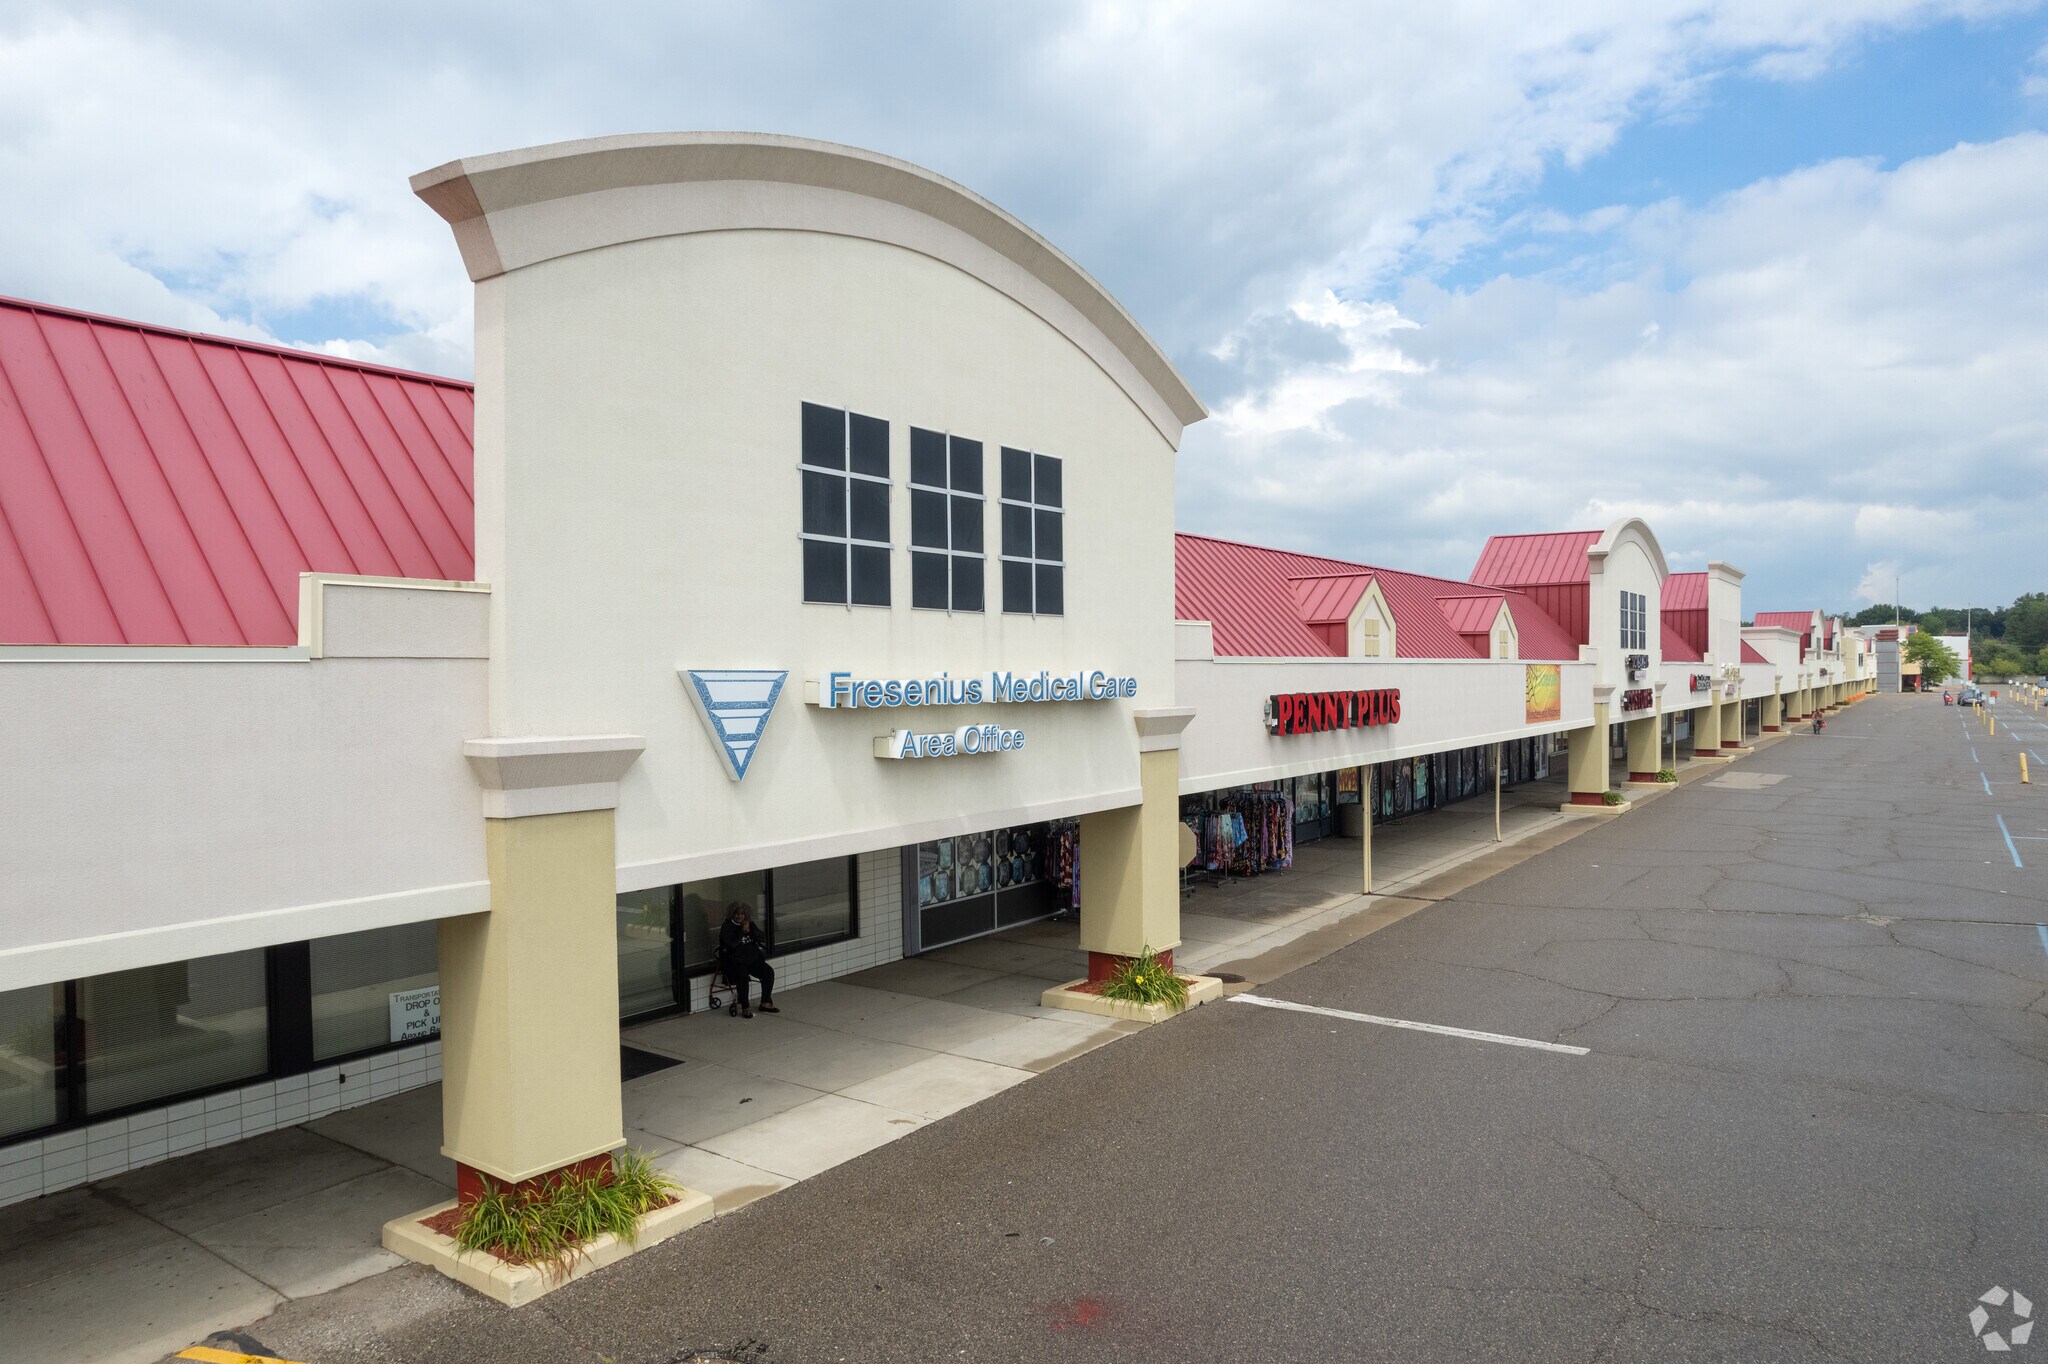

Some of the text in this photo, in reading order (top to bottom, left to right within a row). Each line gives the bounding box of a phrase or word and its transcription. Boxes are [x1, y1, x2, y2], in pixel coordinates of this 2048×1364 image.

[829, 670, 1138, 709] Fresenius Medical Care
[1277, 688, 1401, 736] PENNY PLUS
[900, 725, 1026, 759] Area Office
[406, 999, 430, 1011] DROP
[424, 1009, 430, 1017] &
[406, 1018, 427, 1030] PICK
